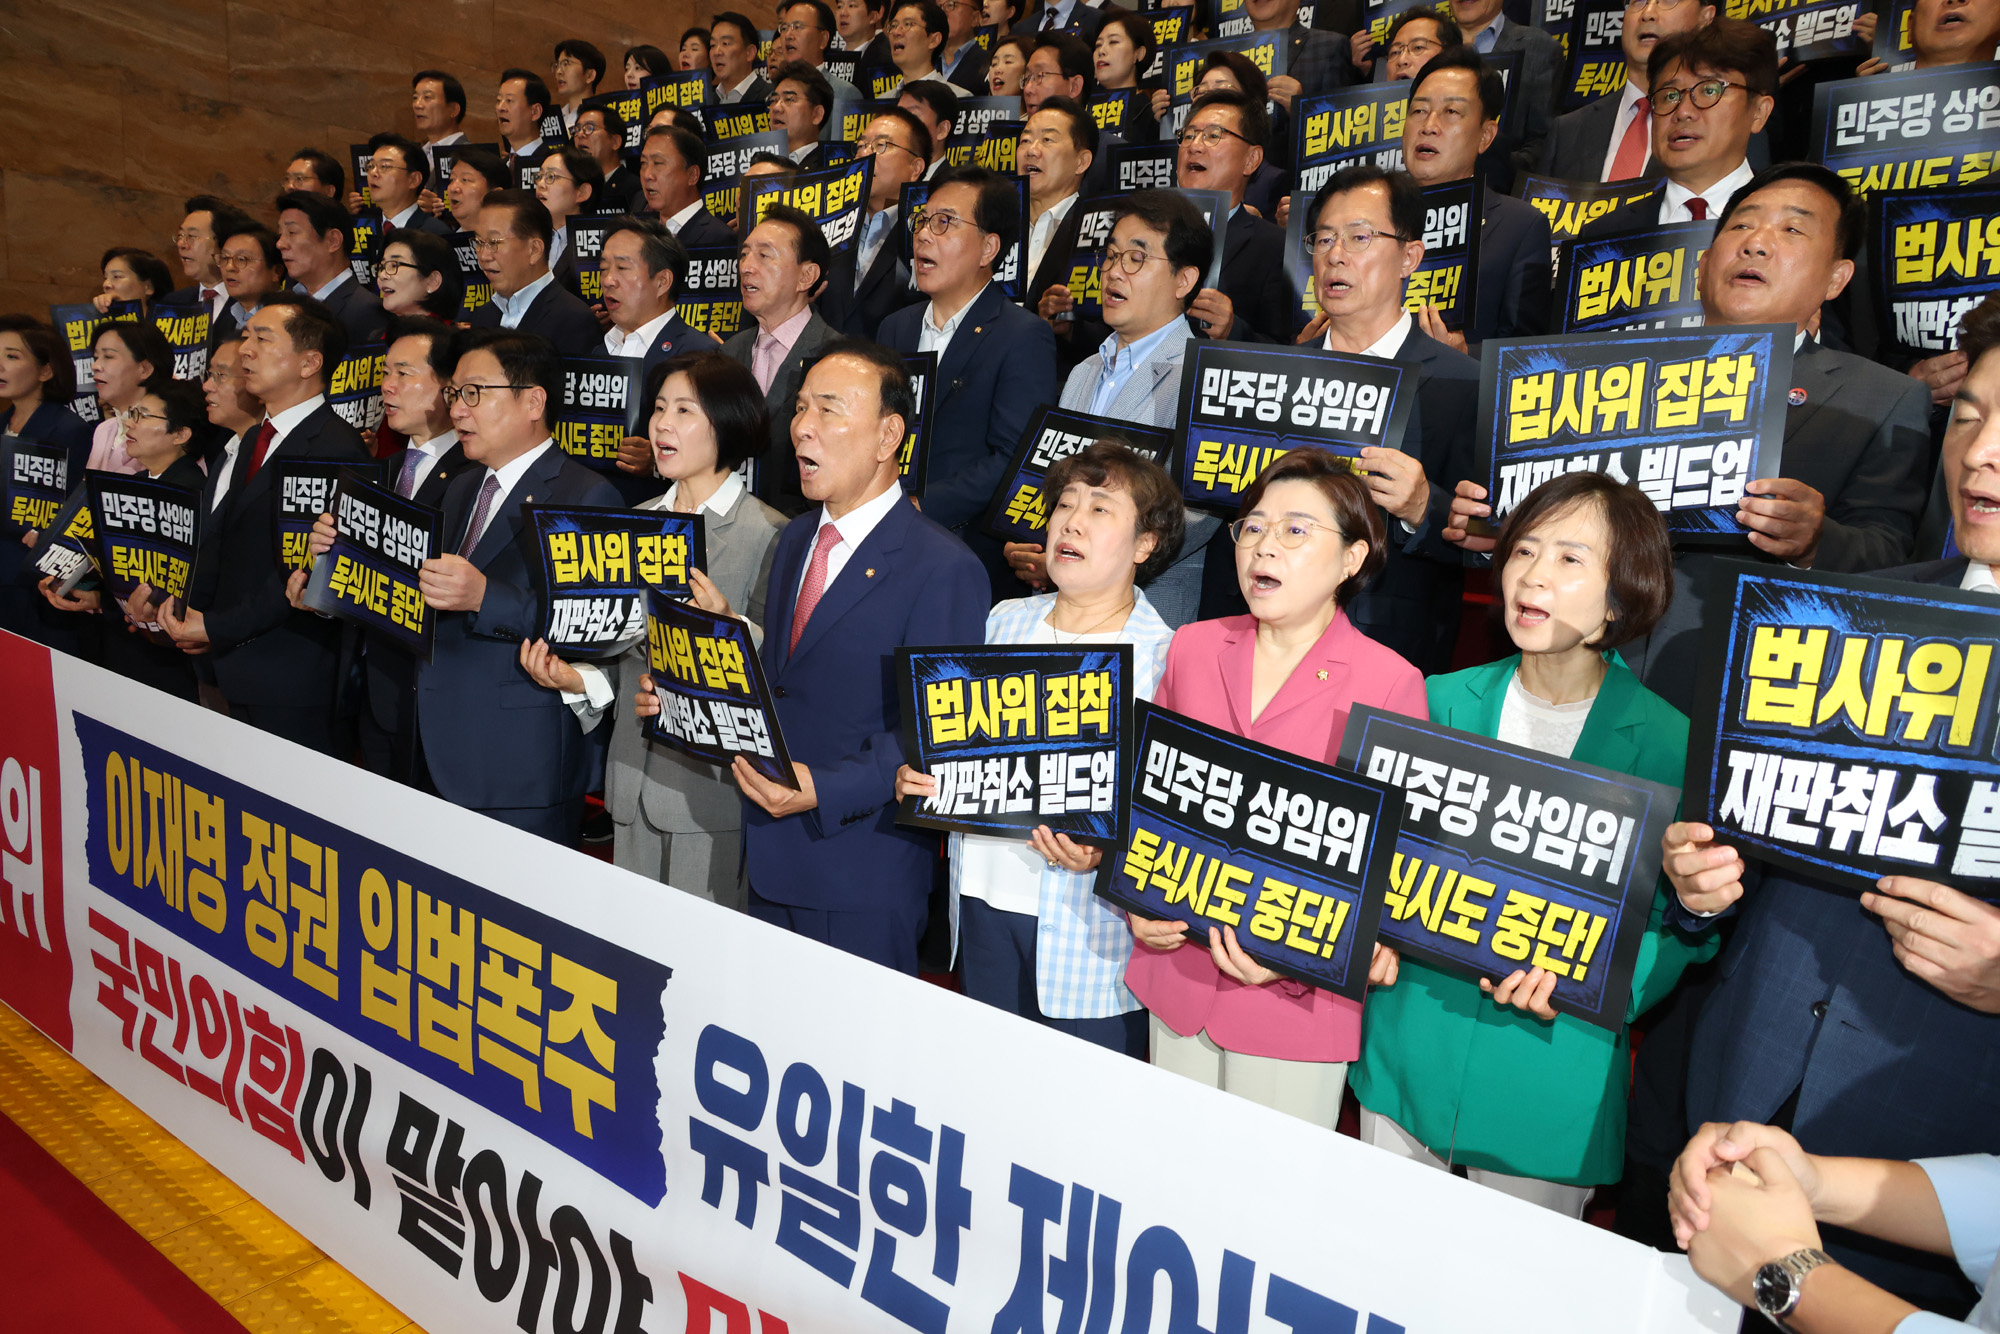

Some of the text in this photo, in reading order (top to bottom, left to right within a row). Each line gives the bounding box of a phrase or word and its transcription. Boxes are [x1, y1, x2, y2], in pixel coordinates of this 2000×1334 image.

[1153, 17, 1182, 44] 집착
[1545, 0, 1575, 22] 민주
[1585, 11, 1624, 46] 민주
[1793, 4, 1858, 48] 빌드업
[680, 79, 704, 104] 집착
[1574, 62, 1628, 97] 독식시
[540, 115, 562, 137] 임위
[618, 99, 641, 122] 집착
[714, 114, 754, 139] 법사위
[756, 112, 770, 133] 집
[1092, 99, 1125, 129] 집착
[1305, 99, 1409, 156] 법사위 집
[1836, 93, 1936, 146] 민주당
[826, 171, 863, 215] 집착
[1120, 158, 1172, 190] 민주당
[575, 229, 603, 257] 민주
[821, 207, 859, 248] 빌드업
[1076, 211, 1116, 248] 민주
[1421, 202, 1469, 250] 임위
[580, 271, 602, 300] 독식
[1067, 266, 1102, 304] 독식
[1403, 265, 1463, 314] 중단!
[1577, 248, 1685, 321] 법사위
[676, 302, 743, 332] 시도 중단!
[1893, 295, 1986, 350] 재판
[329, 353, 386, 395] 법사위 집
[579, 372, 628, 409] 상임위
[366, 398, 385, 429] 빌드
[1200, 367, 1390, 435] 민주당 상임위
[1509, 354, 1756, 444] 법사위 집착
[551, 421, 625, 459] 시도 중단!
[14, 453, 54, 487] 민주당
[1193, 440, 1290, 493] 독식시
[1638, 439, 1753, 512] 빌드업
[101, 491, 157, 533] 민주당
[158, 501, 194, 545] 상임위
[282, 476, 327, 515] 민주당
[1005, 484, 1050, 532] 독식
[282, 531, 315, 570] 독식
[338, 492, 429, 570] 민주당 상임위
[112, 545, 189, 598] 독식시도 중단!
[548, 532, 688, 585] 법사위 집착
[328, 554, 426, 634] 독식시도 중단!
[548, 598, 624, 643] 재판취소
[646, 613, 700, 685] 법사위
[694, 635, 751, 695] 집착
[926, 671, 1113, 744] 법사위 집착
[1745, 626, 1993, 747] 법사위
[654, 685, 775, 758] 재판취소 빌드업
[923, 750, 1116, 816] 재판취소 빌드업
[1142, 739, 1370, 874] 민주당 상임위
[1718, 749, 1947, 865] 재판취소
[1366, 745, 1636, 886] 민주당 상임위
[0, 757, 52, 953] 위
[1123, 827, 1350, 959] 독식시도 중단!
[1384, 852, 1608, 983] 식시도 중단!
[88, 905, 372, 1211] 국민의힘이
[105, 750, 227, 935] 이재명
[240, 809, 340, 1002] 정권
[359, 867, 618, 1140] 입법폭주
[689, 1023, 972, 1334] 유일한
